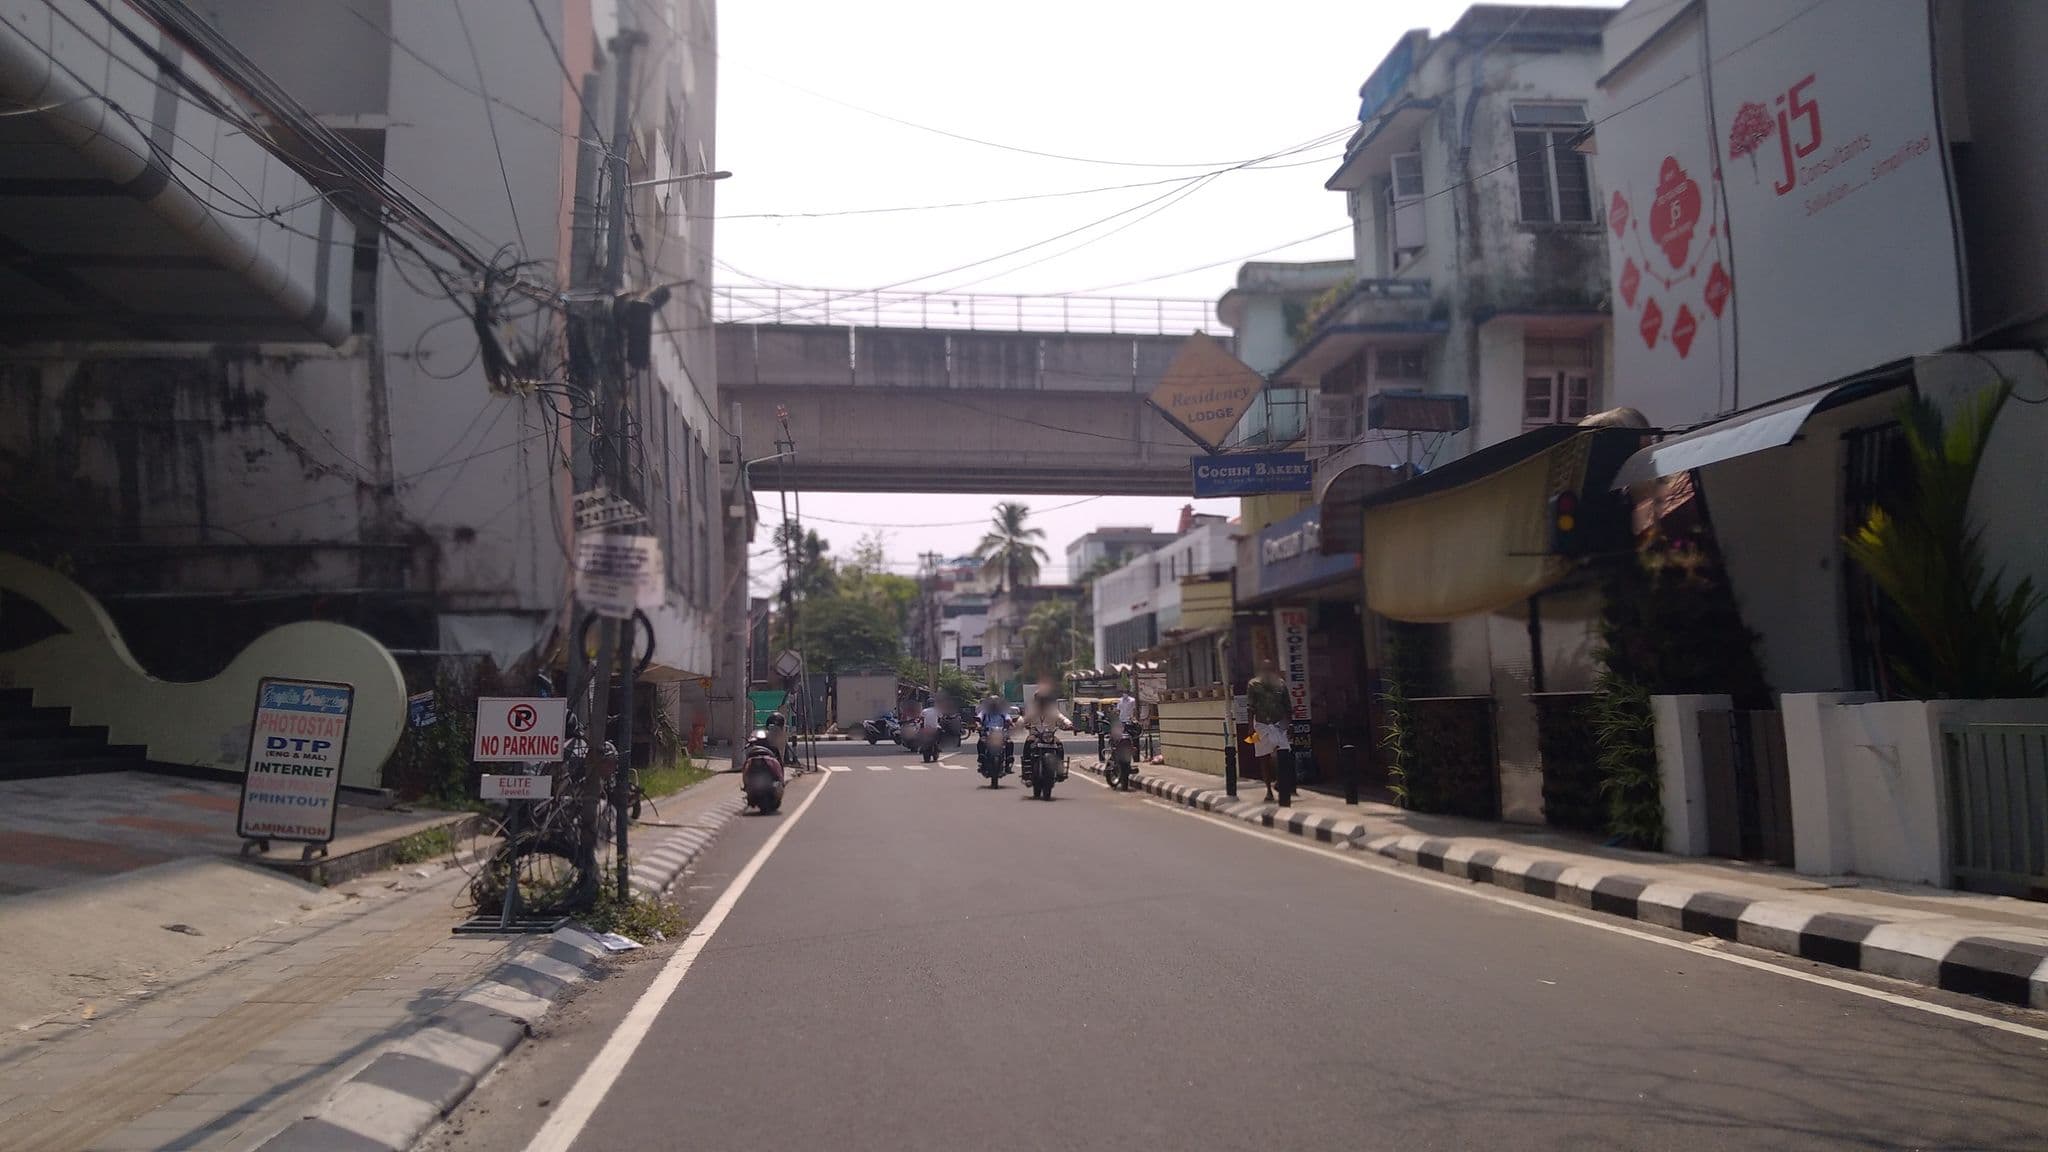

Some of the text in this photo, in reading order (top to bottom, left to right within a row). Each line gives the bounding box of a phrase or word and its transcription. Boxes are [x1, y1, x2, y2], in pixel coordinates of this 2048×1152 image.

[1172, 384, 1249, 407] Residency
[1188, 407, 1235, 424] LODGE
[258, 711, 344, 737] PHOTOSTAT
[266, 736, 331, 753] DTP
[480, 735, 559, 755] NO PARKING
[254, 761, 334, 778] INTERNET
[499, 778, 532, 788] ELITE
[248, 791, 329, 808] PRINTOUT
[244, 821, 327, 836] LAMINATION
